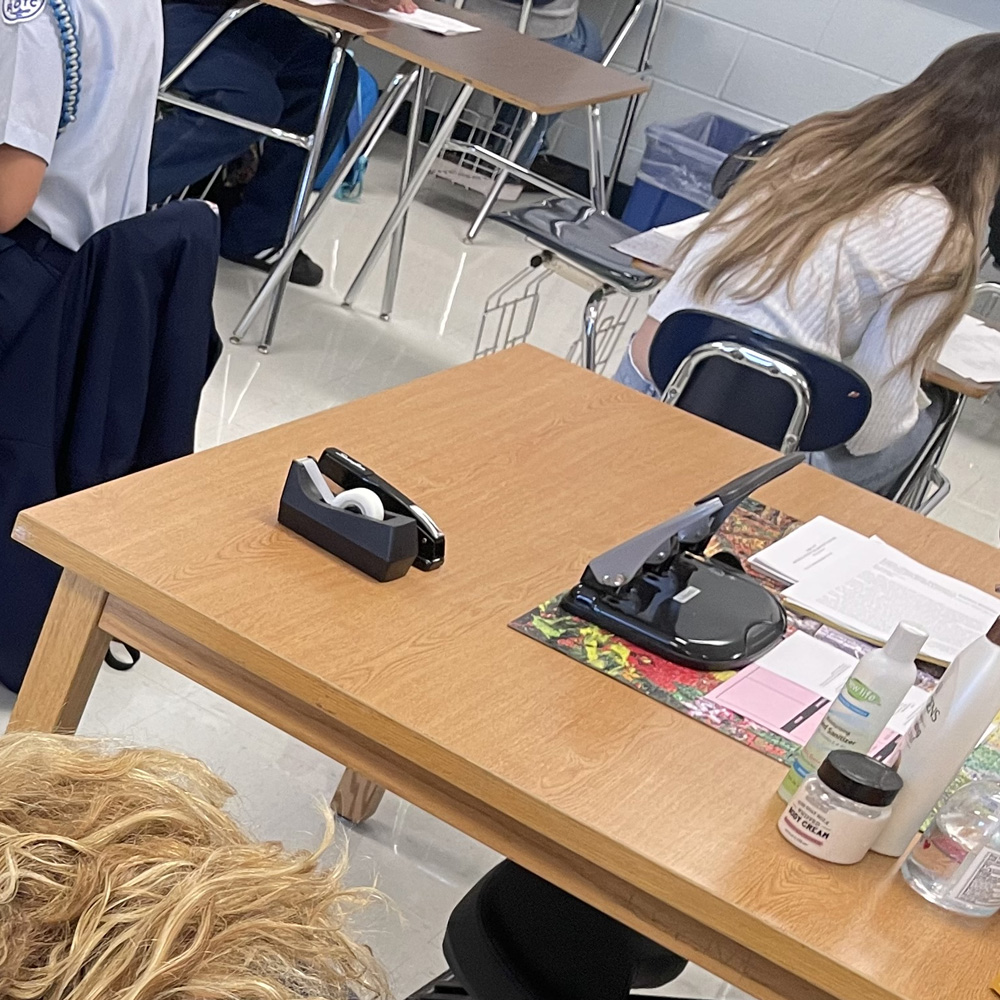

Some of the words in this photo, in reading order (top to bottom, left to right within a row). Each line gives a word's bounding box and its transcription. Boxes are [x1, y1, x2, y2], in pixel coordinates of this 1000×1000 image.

[7, 0, 37, 12] ROTC
[827, 725, 857, 746] Sanitizer
[801, 820, 830, 840] CREAM
